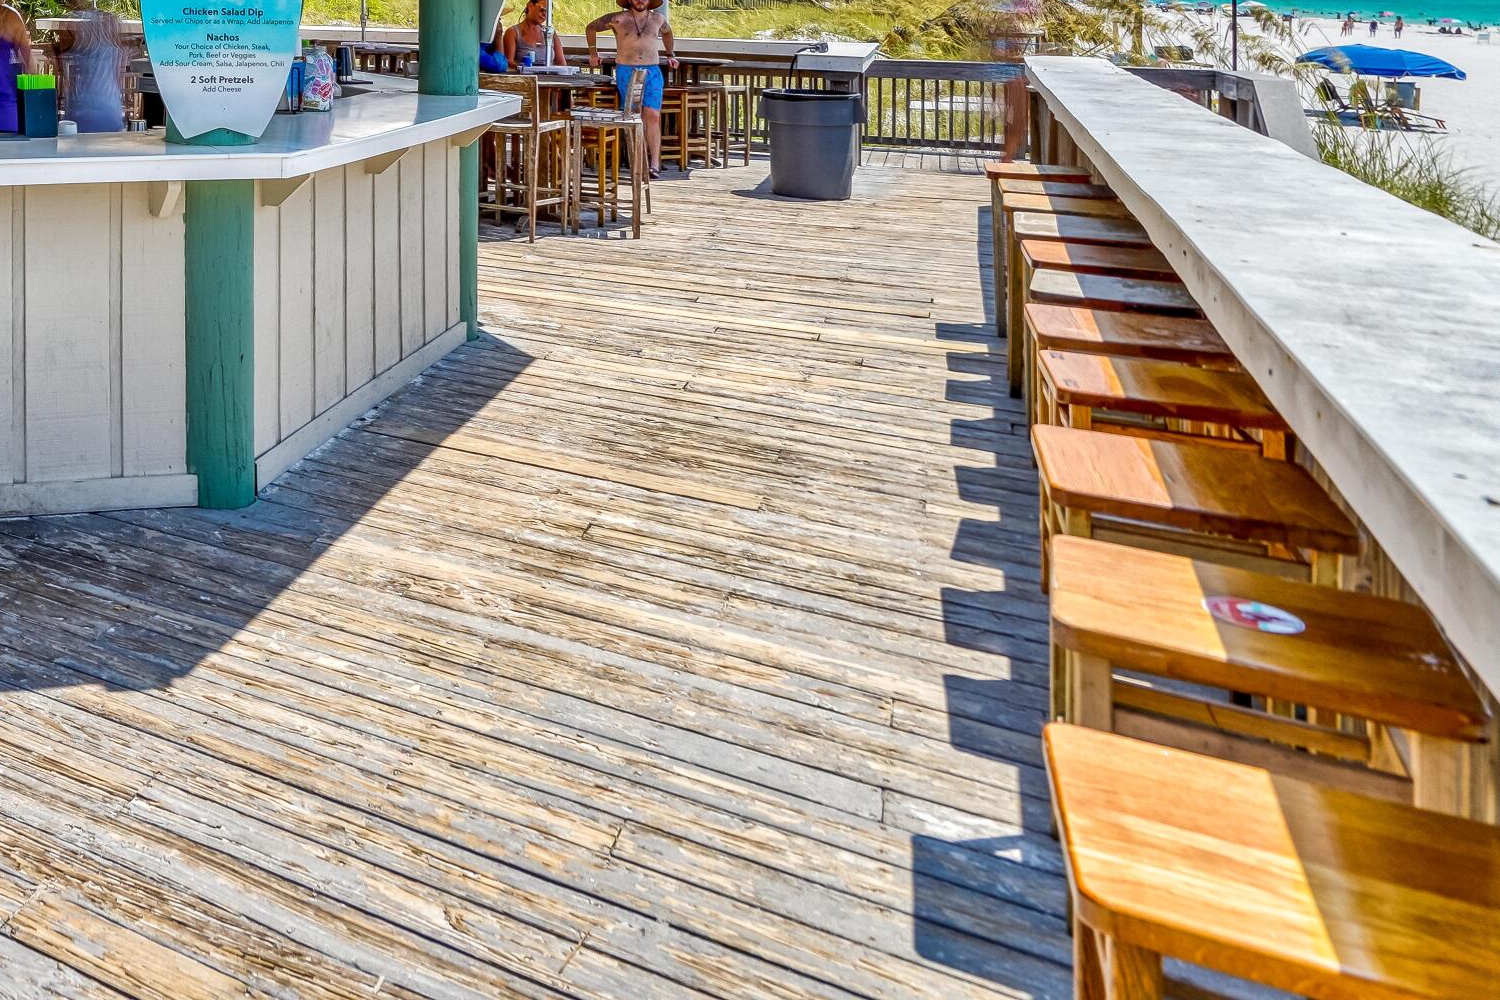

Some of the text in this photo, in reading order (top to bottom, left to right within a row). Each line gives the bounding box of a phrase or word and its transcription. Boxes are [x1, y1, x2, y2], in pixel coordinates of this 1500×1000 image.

[182, 8, 264, 18] Chicken Salad Dip
[206, 33, 240, 41] Nachos
[199, 76, 216, 84] Soft
[219, 76, 254, 84] Pretzels
